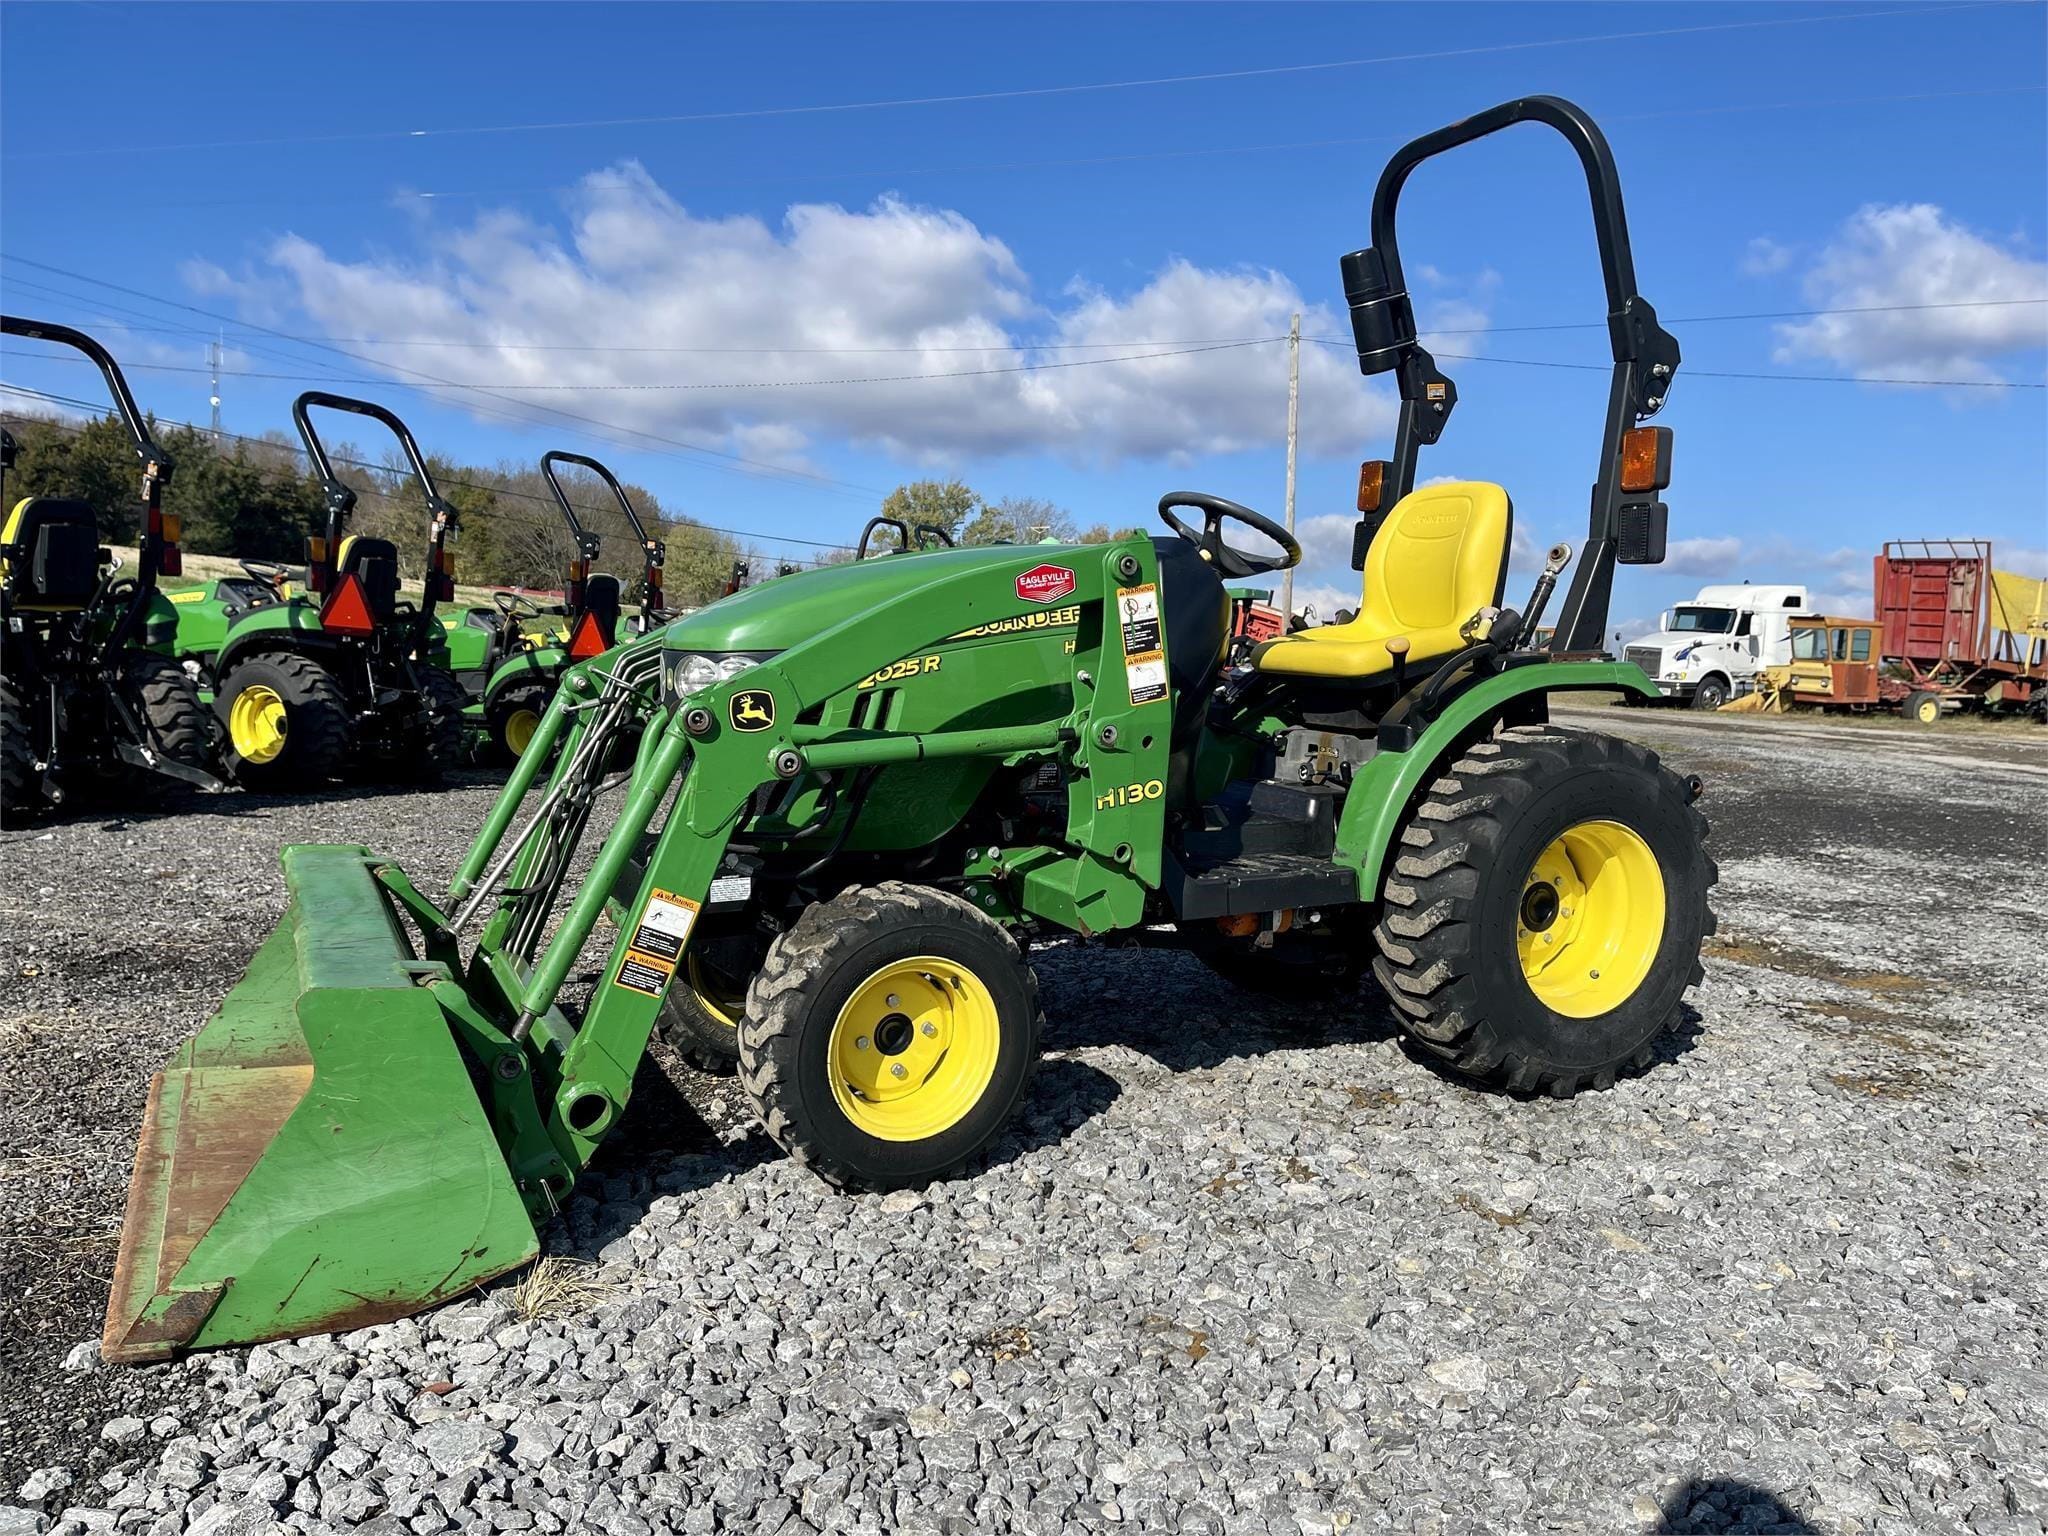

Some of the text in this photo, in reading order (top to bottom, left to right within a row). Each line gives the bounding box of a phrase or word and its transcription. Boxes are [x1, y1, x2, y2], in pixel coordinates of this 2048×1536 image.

[1020, 571, 1070, 586] EAGLEVILLE
[1125, 583, 1154, 596] WARNING
[1034, 607, 1080, 625] DEER
[1133, 652, 1163, 665] WARNING
[857, 655, 942, 690] 2025 R
[1096, 778, 1164, 811] H130
[664, 894, 695, 910] WARNING
[639, 957, 669, 971] WARNING
